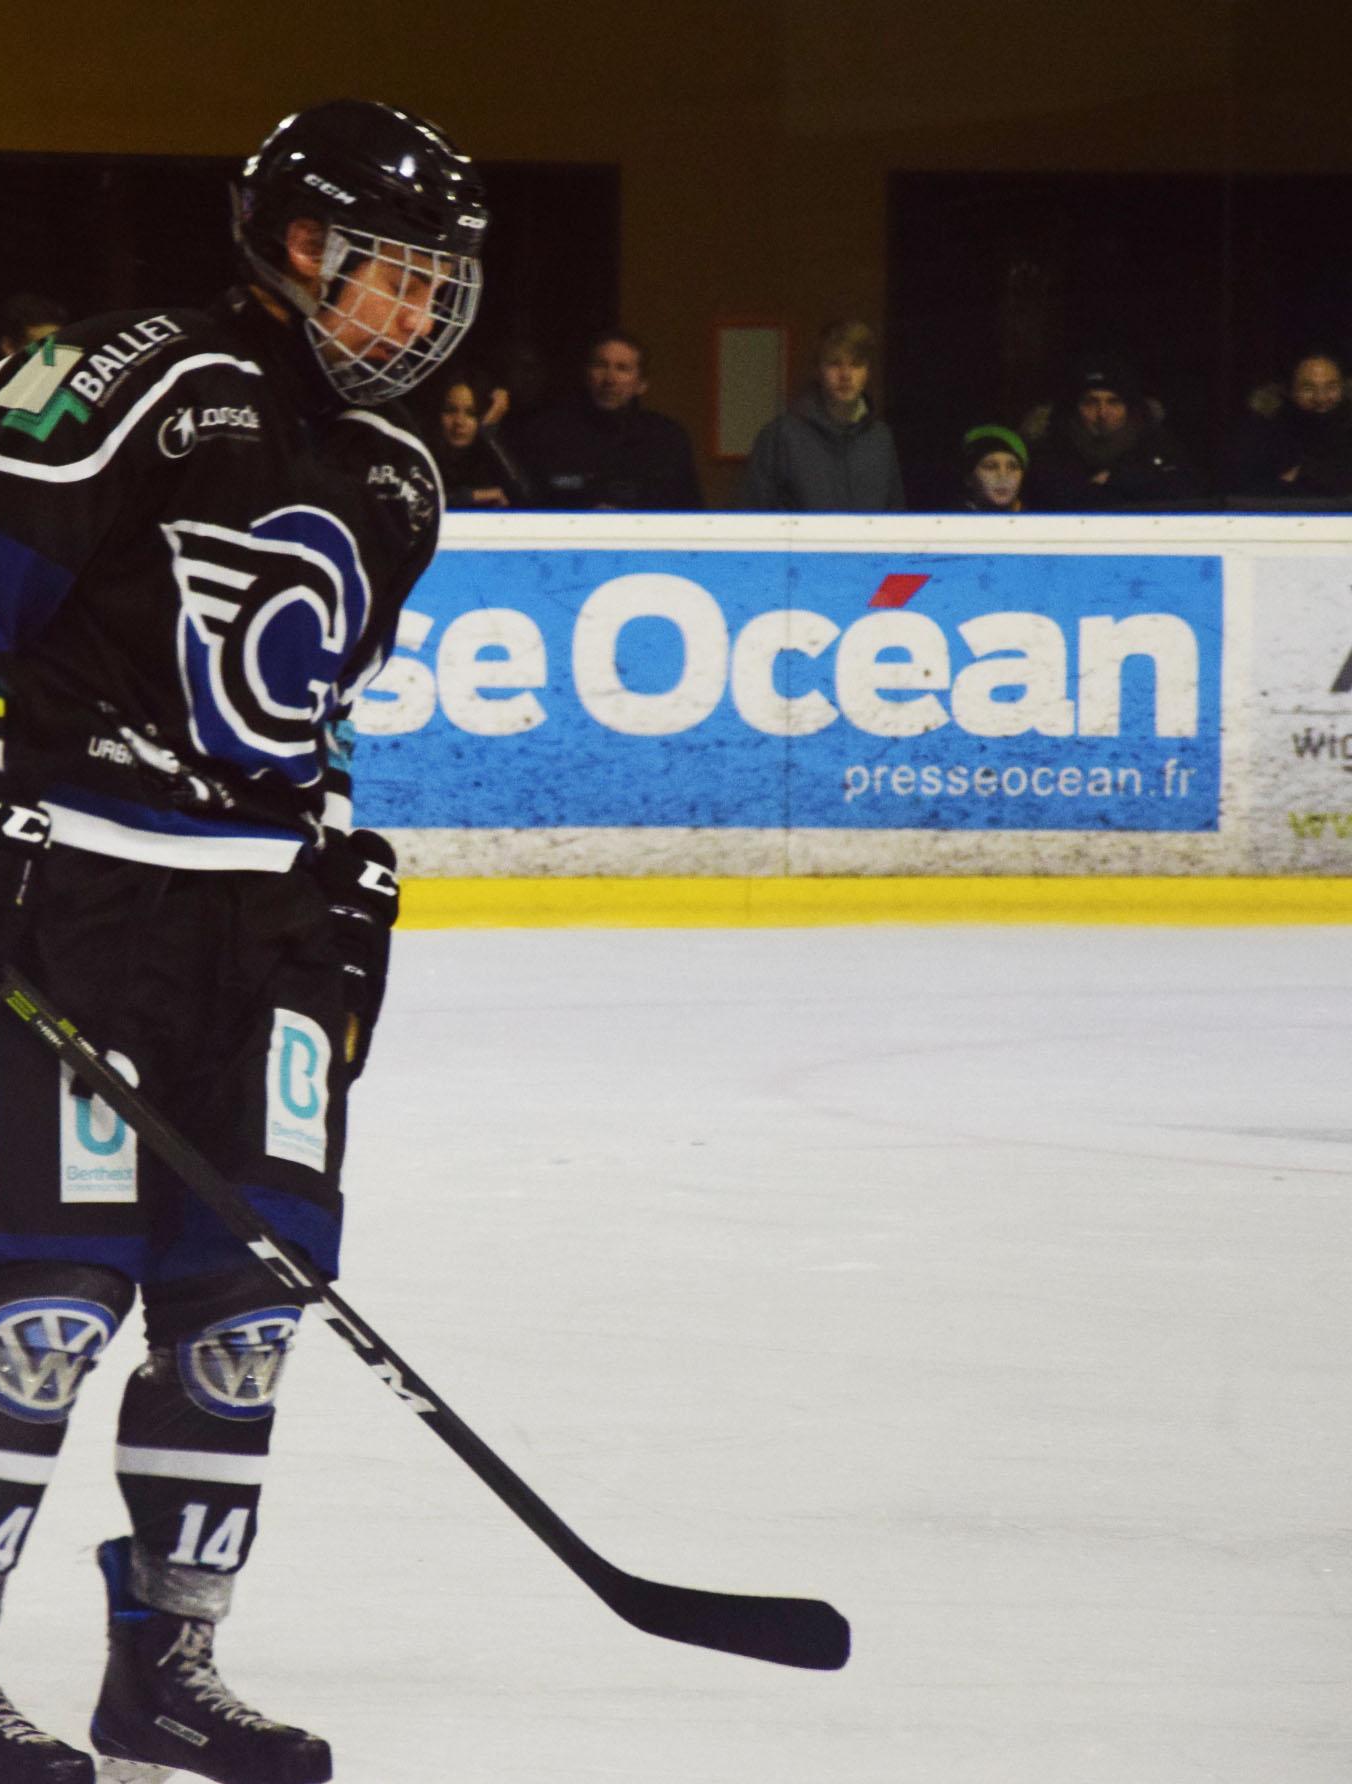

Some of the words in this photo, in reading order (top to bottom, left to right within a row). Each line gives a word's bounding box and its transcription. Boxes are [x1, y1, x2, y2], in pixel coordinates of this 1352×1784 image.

[70, 315, 182, 402] BALLET
[572, 572, 1200, 737] Océan
[844, 757, 1196, 803] presseocean.fr
[167, 1503, 250, 1572] 14
